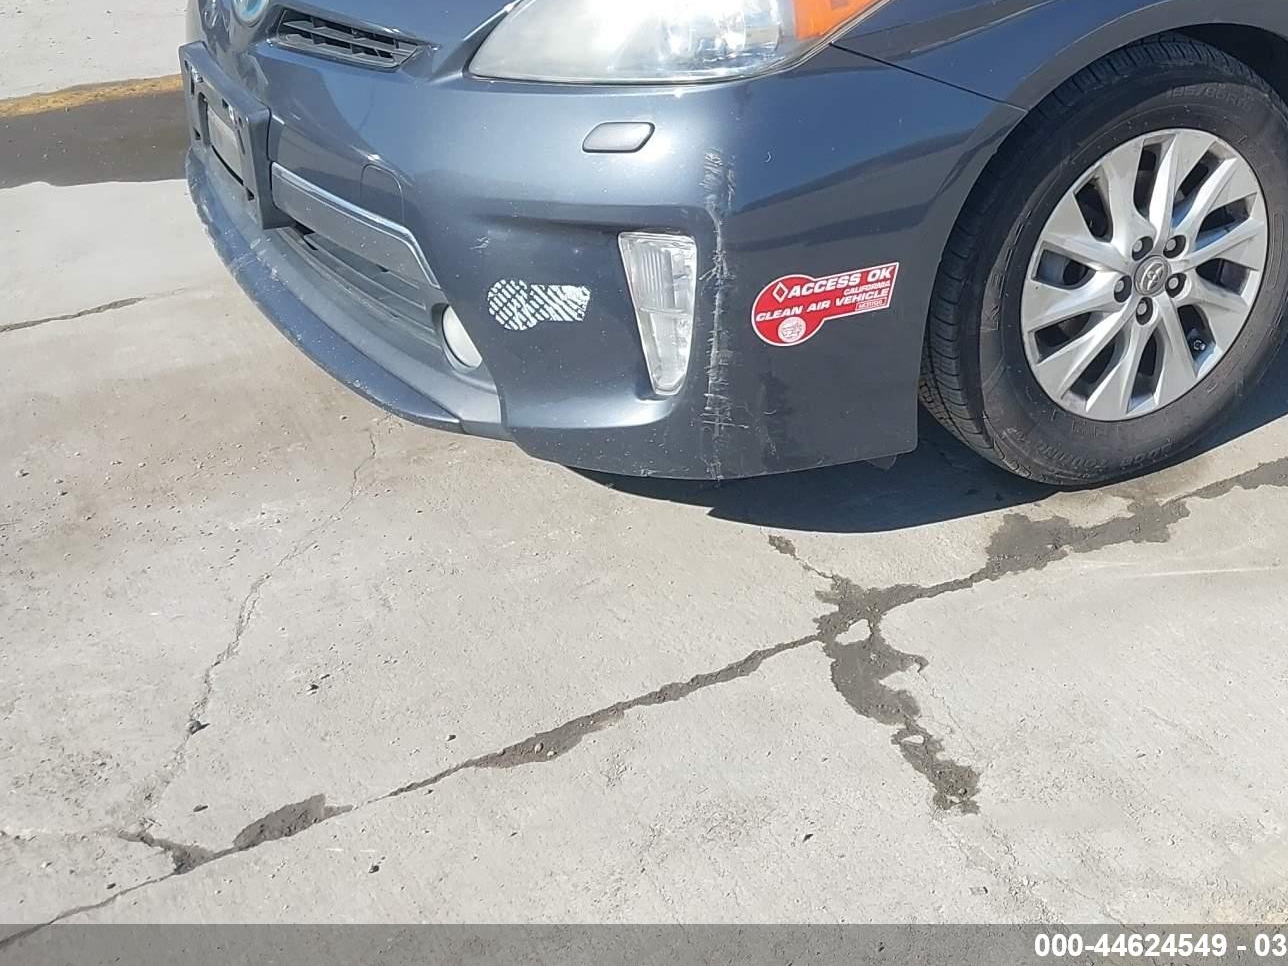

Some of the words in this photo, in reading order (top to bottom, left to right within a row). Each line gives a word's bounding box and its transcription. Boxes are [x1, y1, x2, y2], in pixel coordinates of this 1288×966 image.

[787, 272, 862, 299] ACCESS
[867, 265, 896, 281] OK
[843, 279, 891, 296] CALIFORNIA
[755, 305, 804, 322] CLEAN
[806, 300, 831, 313] AIR
[835, 288, 890, 307] VEHICLE
